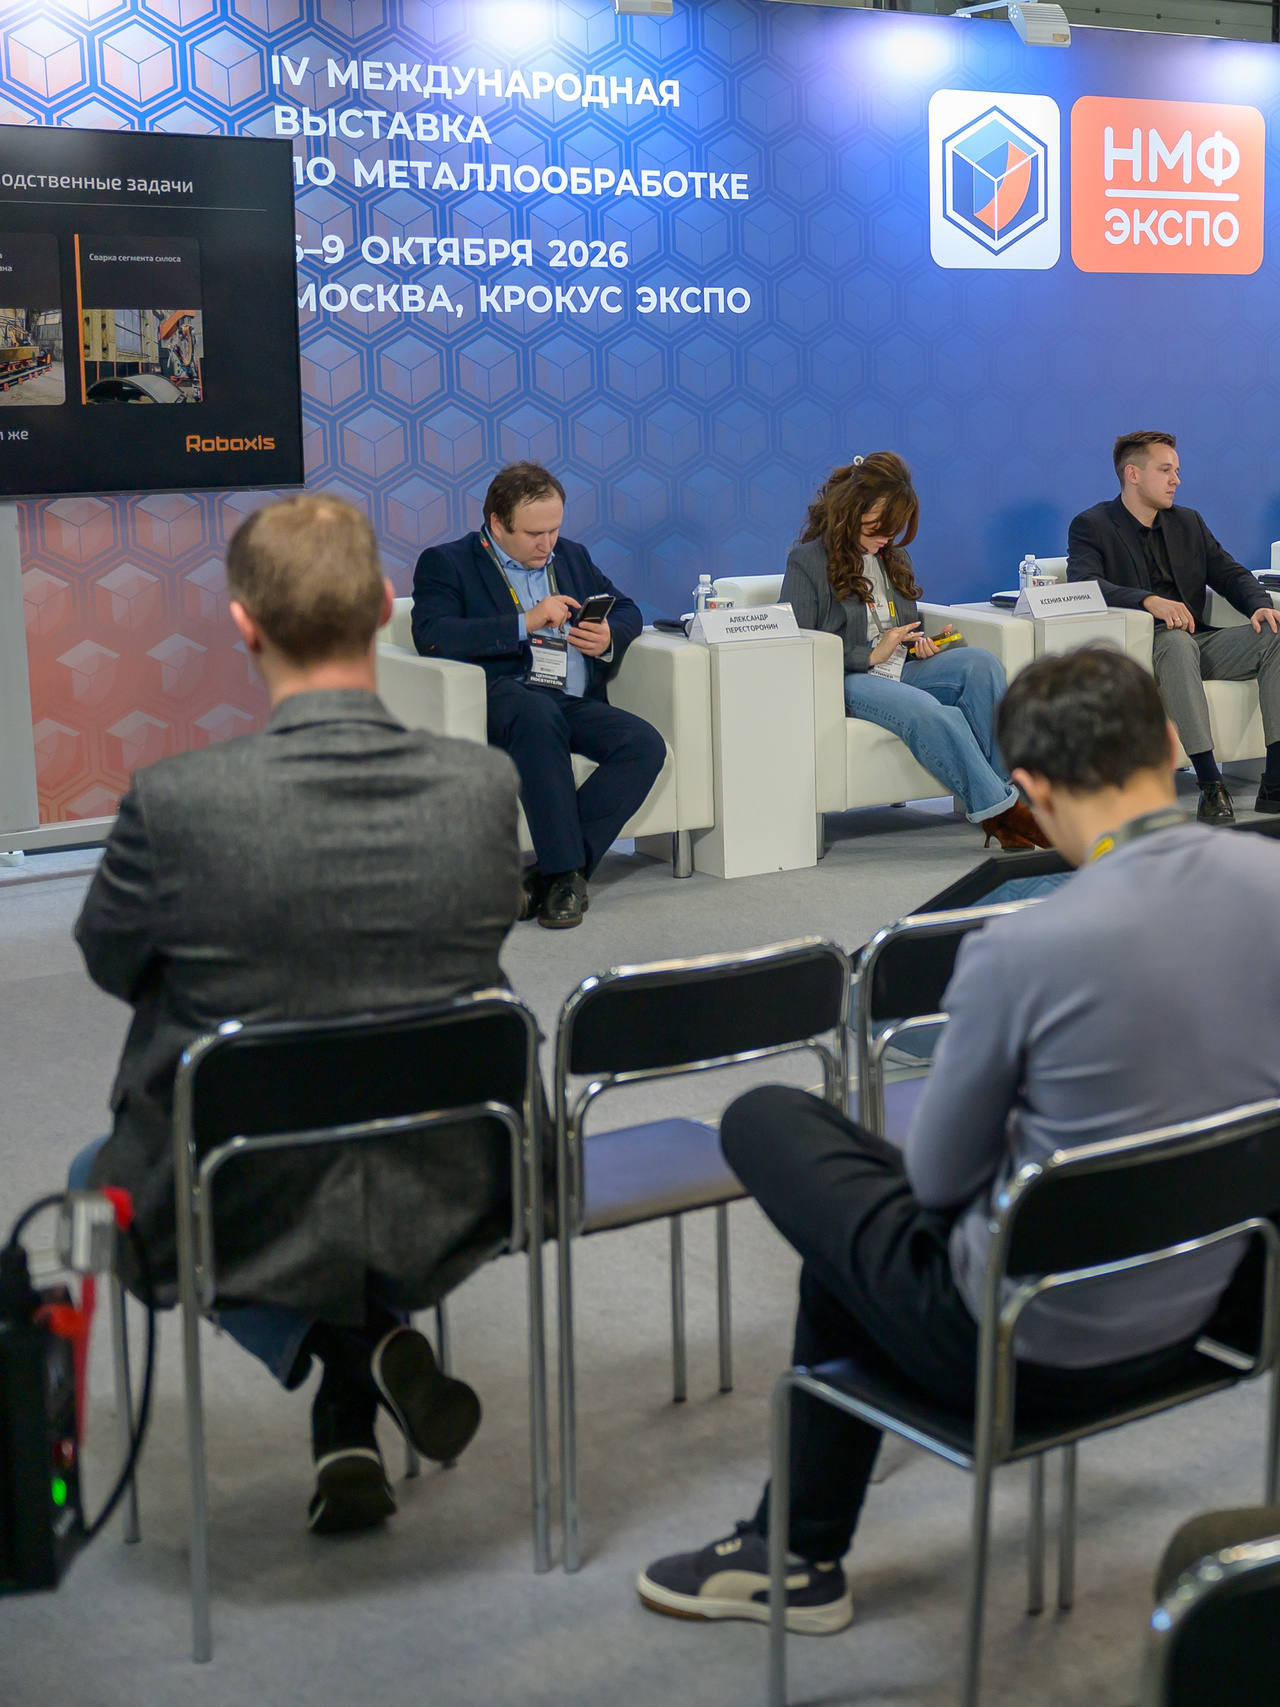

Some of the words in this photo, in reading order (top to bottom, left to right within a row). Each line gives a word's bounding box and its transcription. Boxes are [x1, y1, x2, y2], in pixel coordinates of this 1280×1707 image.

[271, 54, 311, 86] IV
[327, 58, 681, 108] МЕЖДУНАРОДНАЯ
[273, 105, 493, 144] ВЫСТАВКА
[1104, 126, 1241, 187] НМФ
[0, 173, 122, 191] одственные
[126, 178, 194, 195] задачи
[353, 158, 751, 200] МЕТАЛЛООБРАБОТКЕ
[1104, 207, 1240, 248] ЭКСПО
[89, 252, 117, 263] Сварка
[118, 253, 154, 263] сегмента
[154, 254, 182, 263] силоса
[361, 235, 533, 268] ОКТЯБРЯ
[547, 239, 629, 268] 2026
[480, 285, 623, 314] КРОКУС
[635, 286, 751, 314] ЭКСПО
[8, 430, 29, 440] же
[1040, 597, 1062, 605] КСЕНИЯ
[725, 623, 779, 634] ПЕРЕСТОРОНИН
[729, 613, 769, 623] АЛЕКСАНДР
